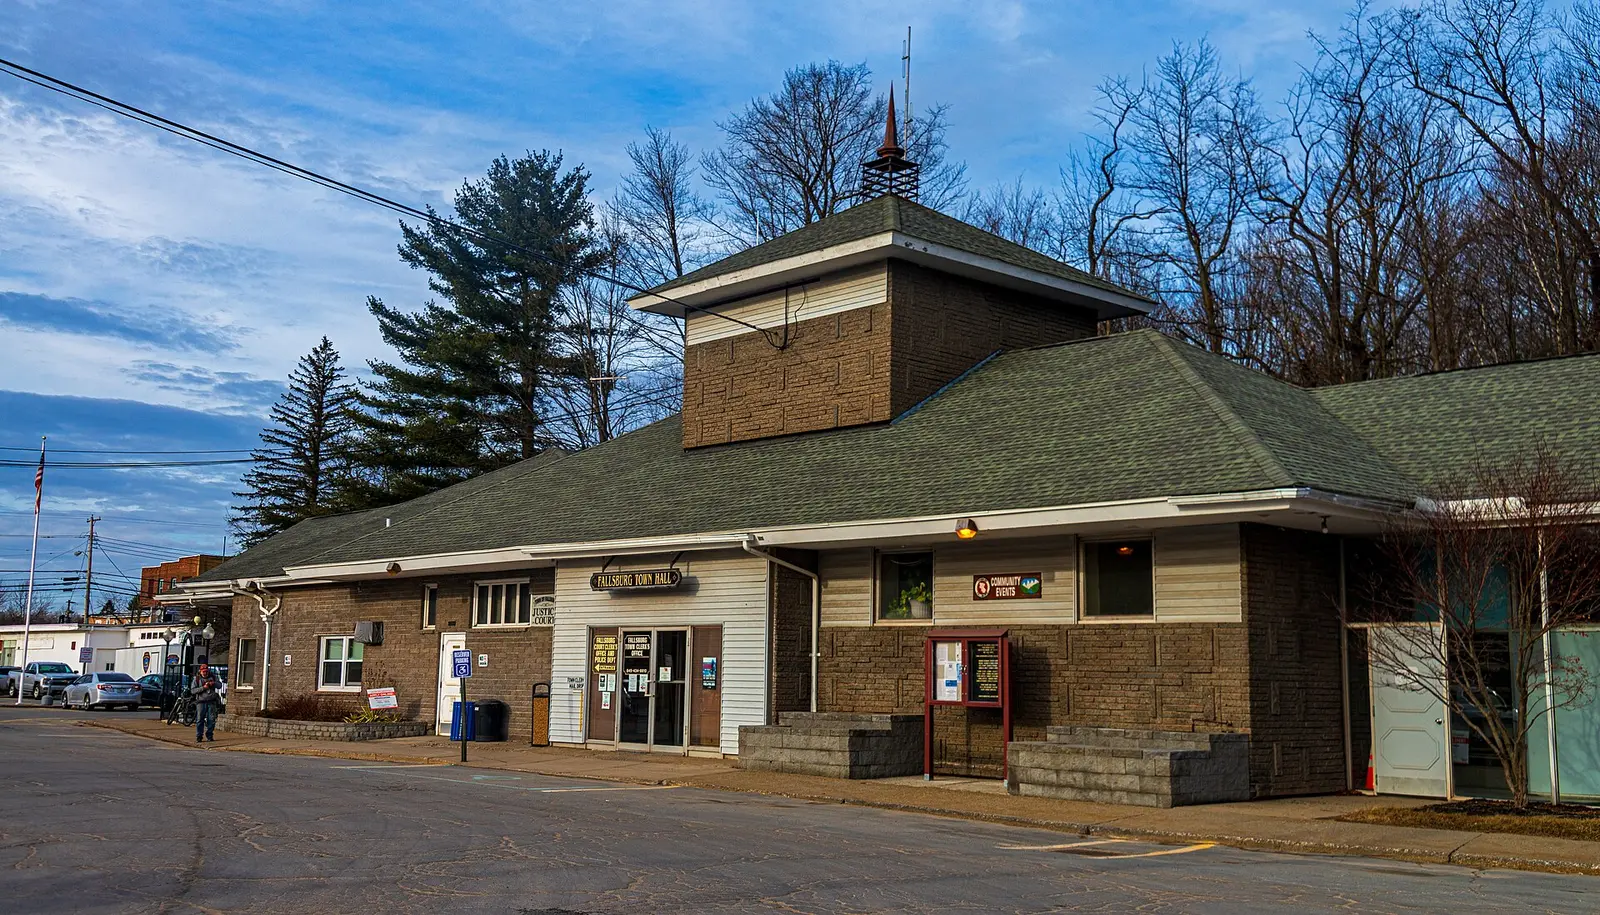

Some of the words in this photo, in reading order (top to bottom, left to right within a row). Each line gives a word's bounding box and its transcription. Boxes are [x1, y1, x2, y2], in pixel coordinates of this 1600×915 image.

[597, 574, 633, 587] FALLSBURG
[635, 573, 653, 586] TOWN
[655, 572, 672, 585] HALL
[990, 576, 1021, 587] COMMUNITY
[995, 587, 1016, 597] EVENTS
